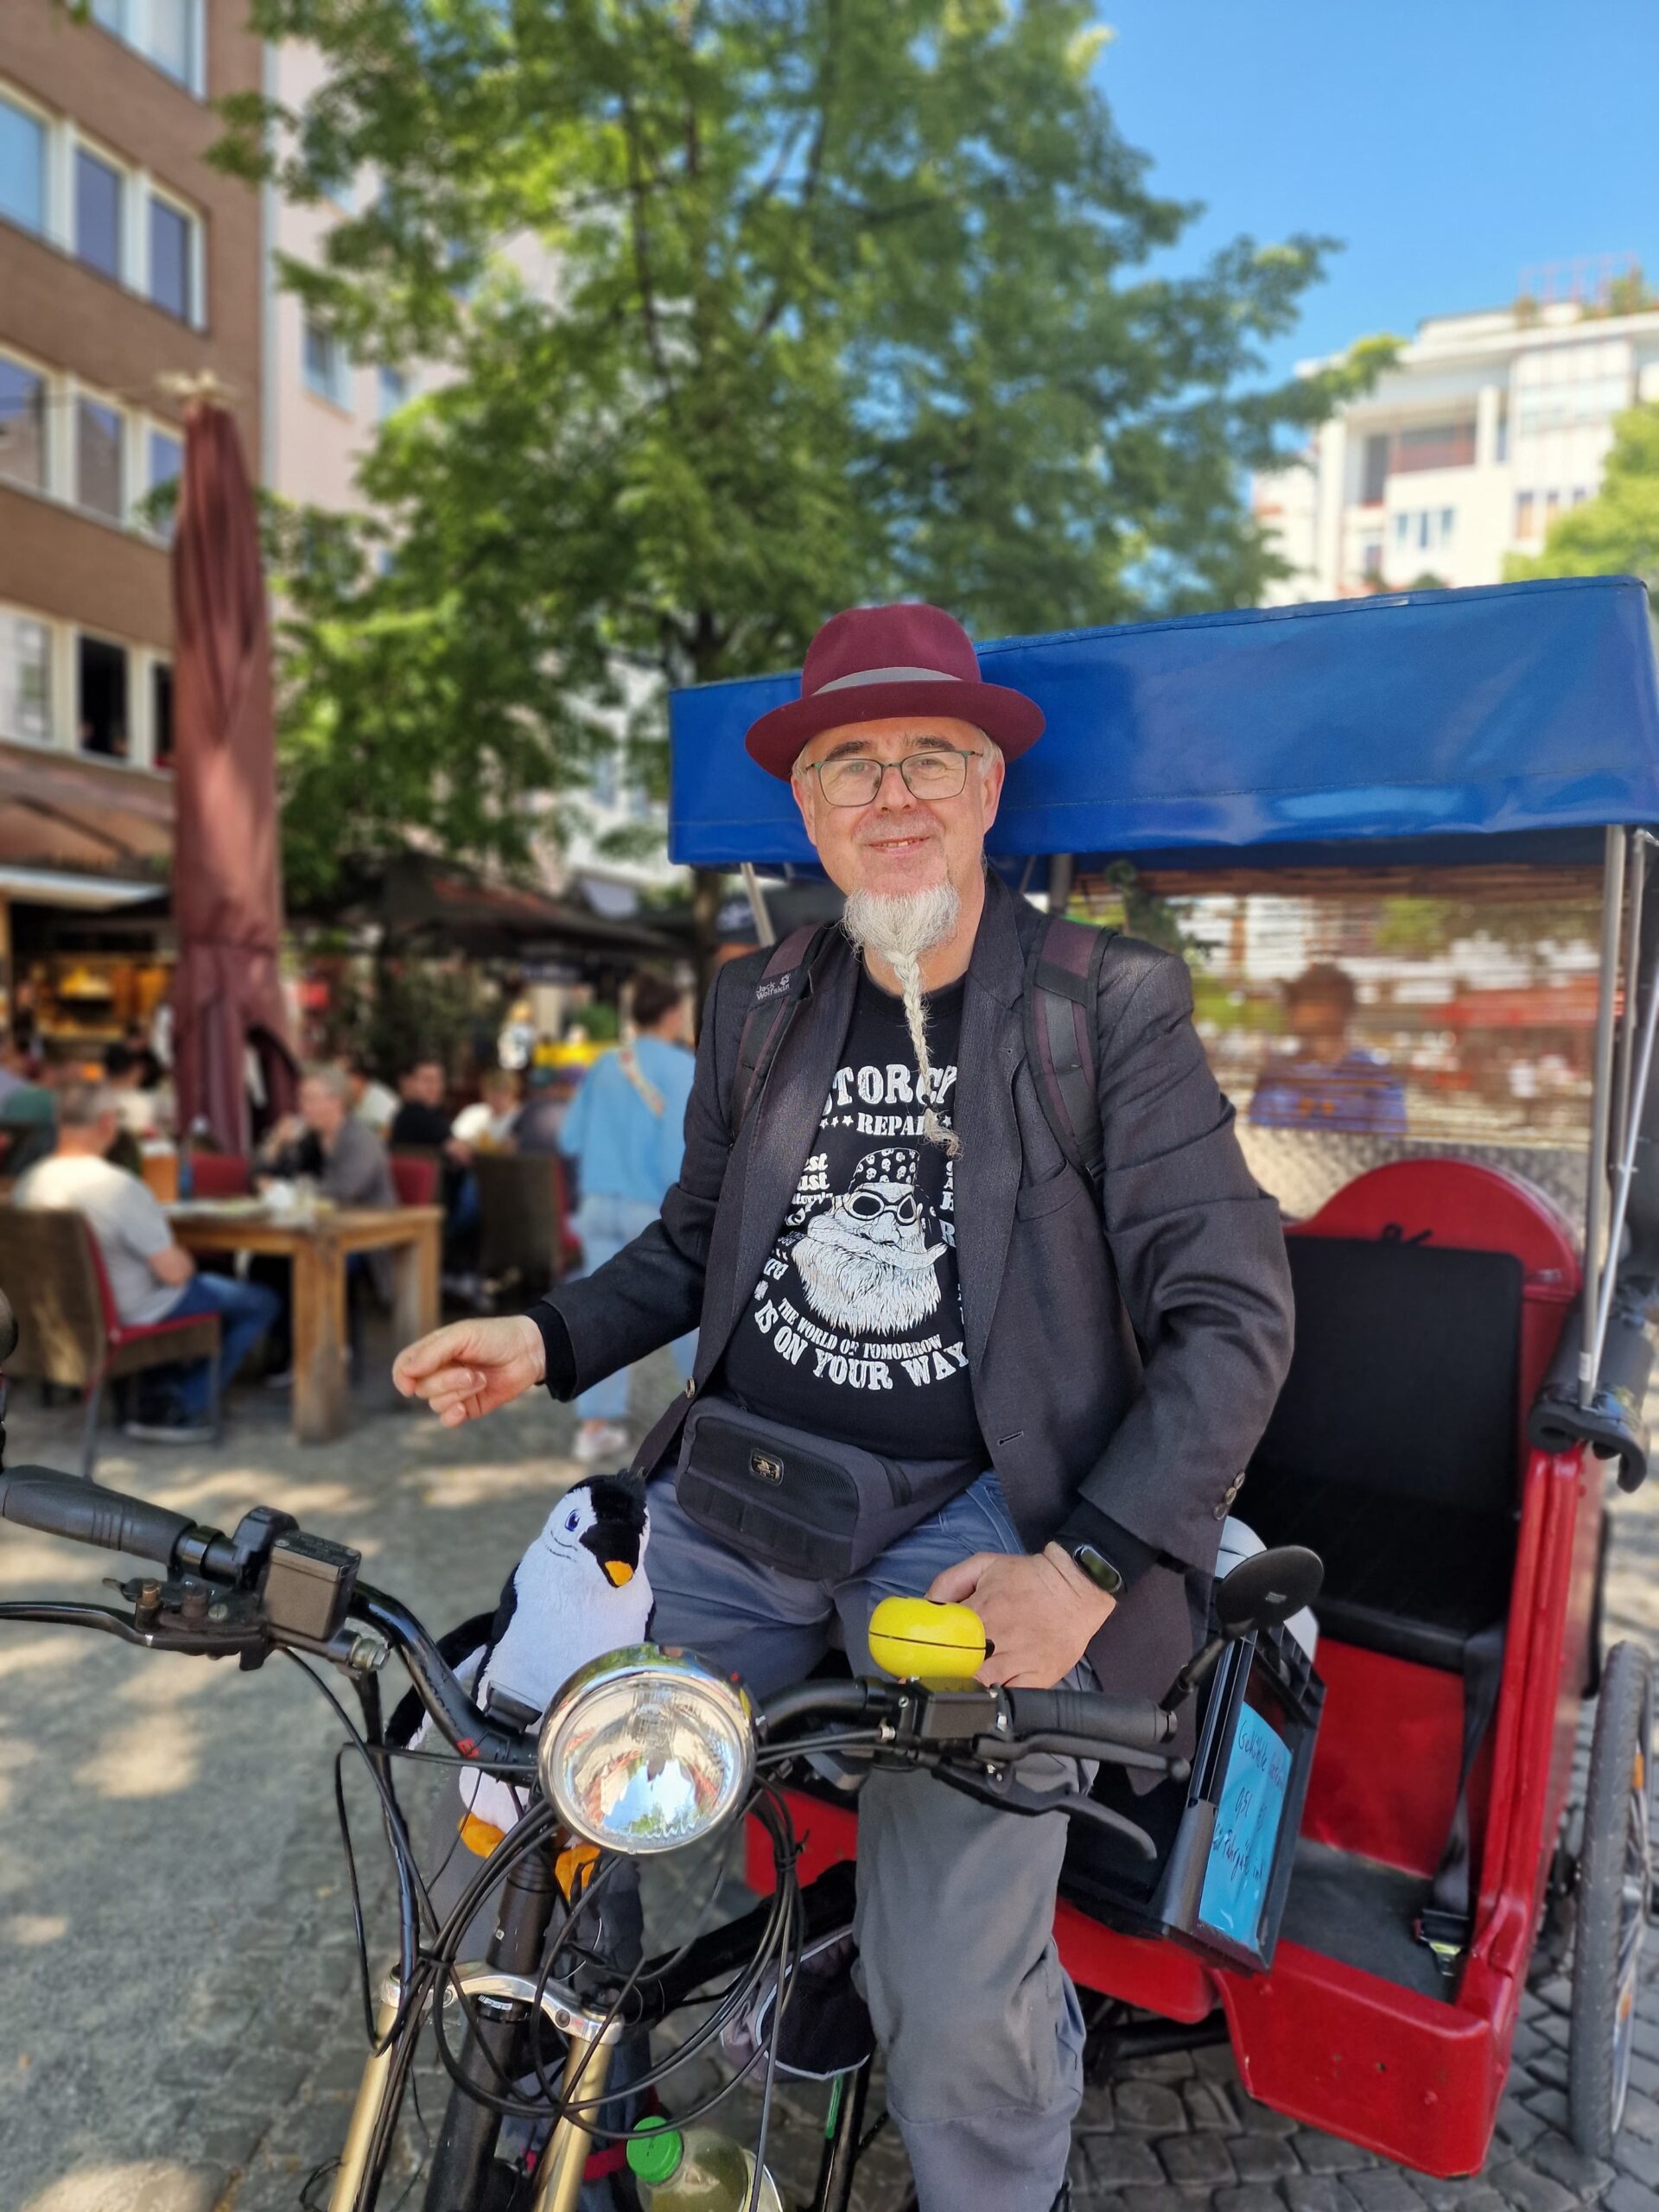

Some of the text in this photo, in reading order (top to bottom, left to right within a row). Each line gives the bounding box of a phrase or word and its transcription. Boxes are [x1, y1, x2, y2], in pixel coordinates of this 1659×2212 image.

[756, 983, 790, 1001] Wolfskin
[757, 982, 776, 993] Jack
[856, 1112, 930, 1136] REPAI
[778, 1297, 943, 1360] THE WORLD OF TOMORROW
[754, 1299, 969, 1390] IS ON YOUR WAY
